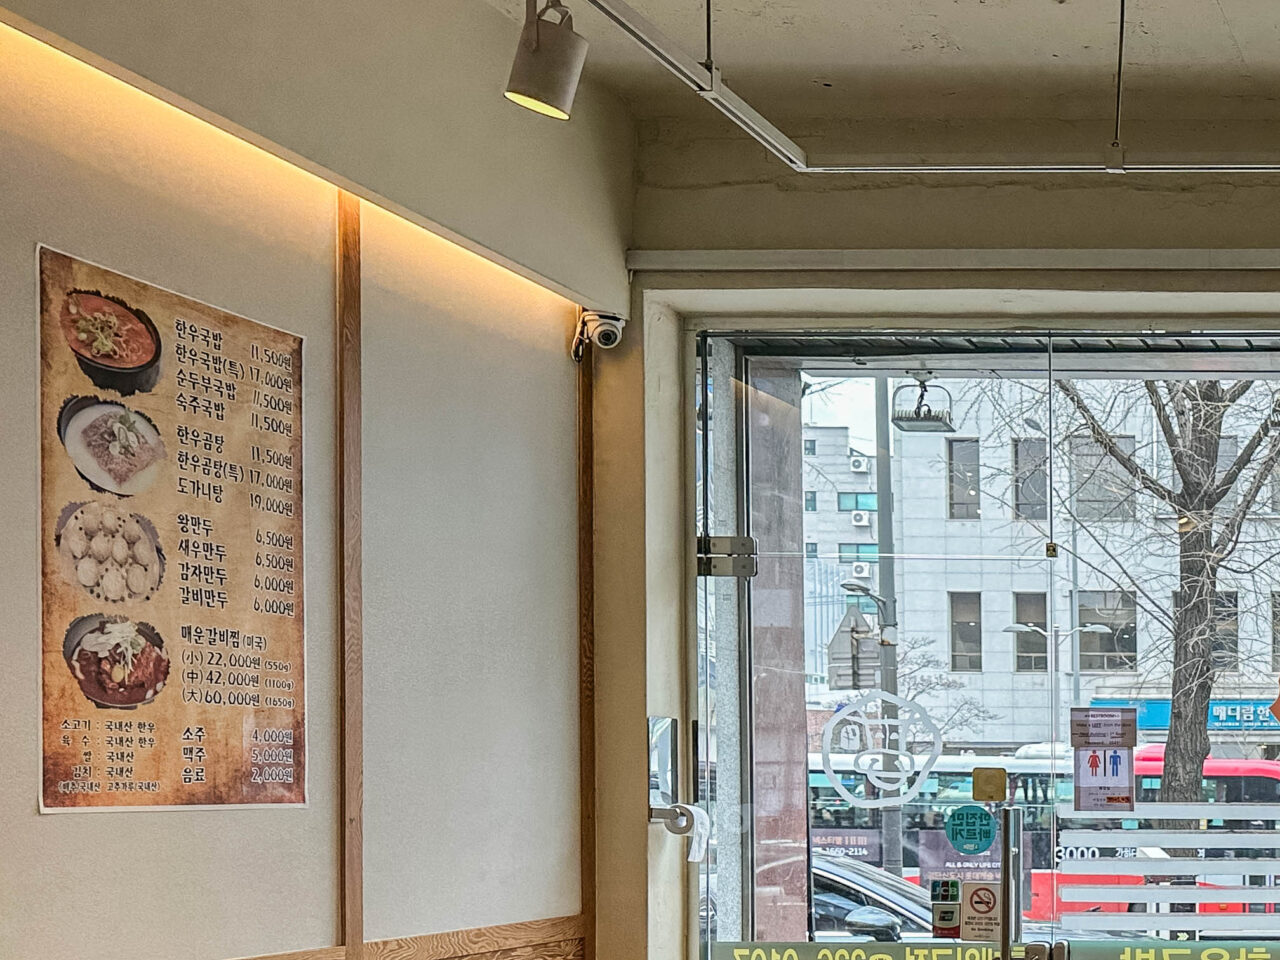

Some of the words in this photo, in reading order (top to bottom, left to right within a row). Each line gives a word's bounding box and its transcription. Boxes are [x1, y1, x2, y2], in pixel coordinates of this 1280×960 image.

[175, 318, 223, 350] 한우국밥
[251, 345, 292, 371] 11,500원
[175, 344, 245, 380] 한우국밥(특)
[250, 367, 292, 393] 17,000원
[176, 368, 237, 400] 순두부국밥
[252, 391, 292, 415] 11,500원
[176, 392, 226, 421] 숙주국밥
[251, 413, 293, 437] 11,500원
[177, 425, 225, 454] 한우곰탕
[251, 446, 293, 470] 11,500원
[177, 450, 245, 482] 한우곰탕(특)
[250, 470, 293, 493] 17,000원
[177, 477, 224, 503] 도가니탕
[250, 494, 293, 516] 19,000원
[177, 514, 214, 537] 왕만두
[255, 529, 294, 549] 6,500원
[178, 541, 227, 563] 새우만두
[255, 552, 294, 572] 6,500원
[178, 563, 228, 586] 감자만두
[254, 574, 294, 594] 6,000원
[179, 587, 229, 608] 갈비만두
[253, 597, 295, 617] 6,000원
[207, 652, 260, 669] 22,000원
[206, 671, 259, 688] 42,000원
[204, 690, 260, 707] 60,000원
[61, 720, 91, 731] 소고기
[105, 721, 133, 732] 국내산
[137, 722, 155, 733] 한우
[182, 727, 205, 741] 소주
[251, 728, 293, 744] 4,000원
[105, 736, 134, 748] 국내산
[137, 737, 156, 748] 한우
[106, 751, 134, 763] 국내산
[182, 747, 206, 763] 맥주
[251, 749, 293, 764] 5,000원
[73, 766, 92, 778] 김치
[105, 766, 133, 778] 국내산
[182, 767, 205, 784] 음료
[251, 766, 293, 783] 2,000원
